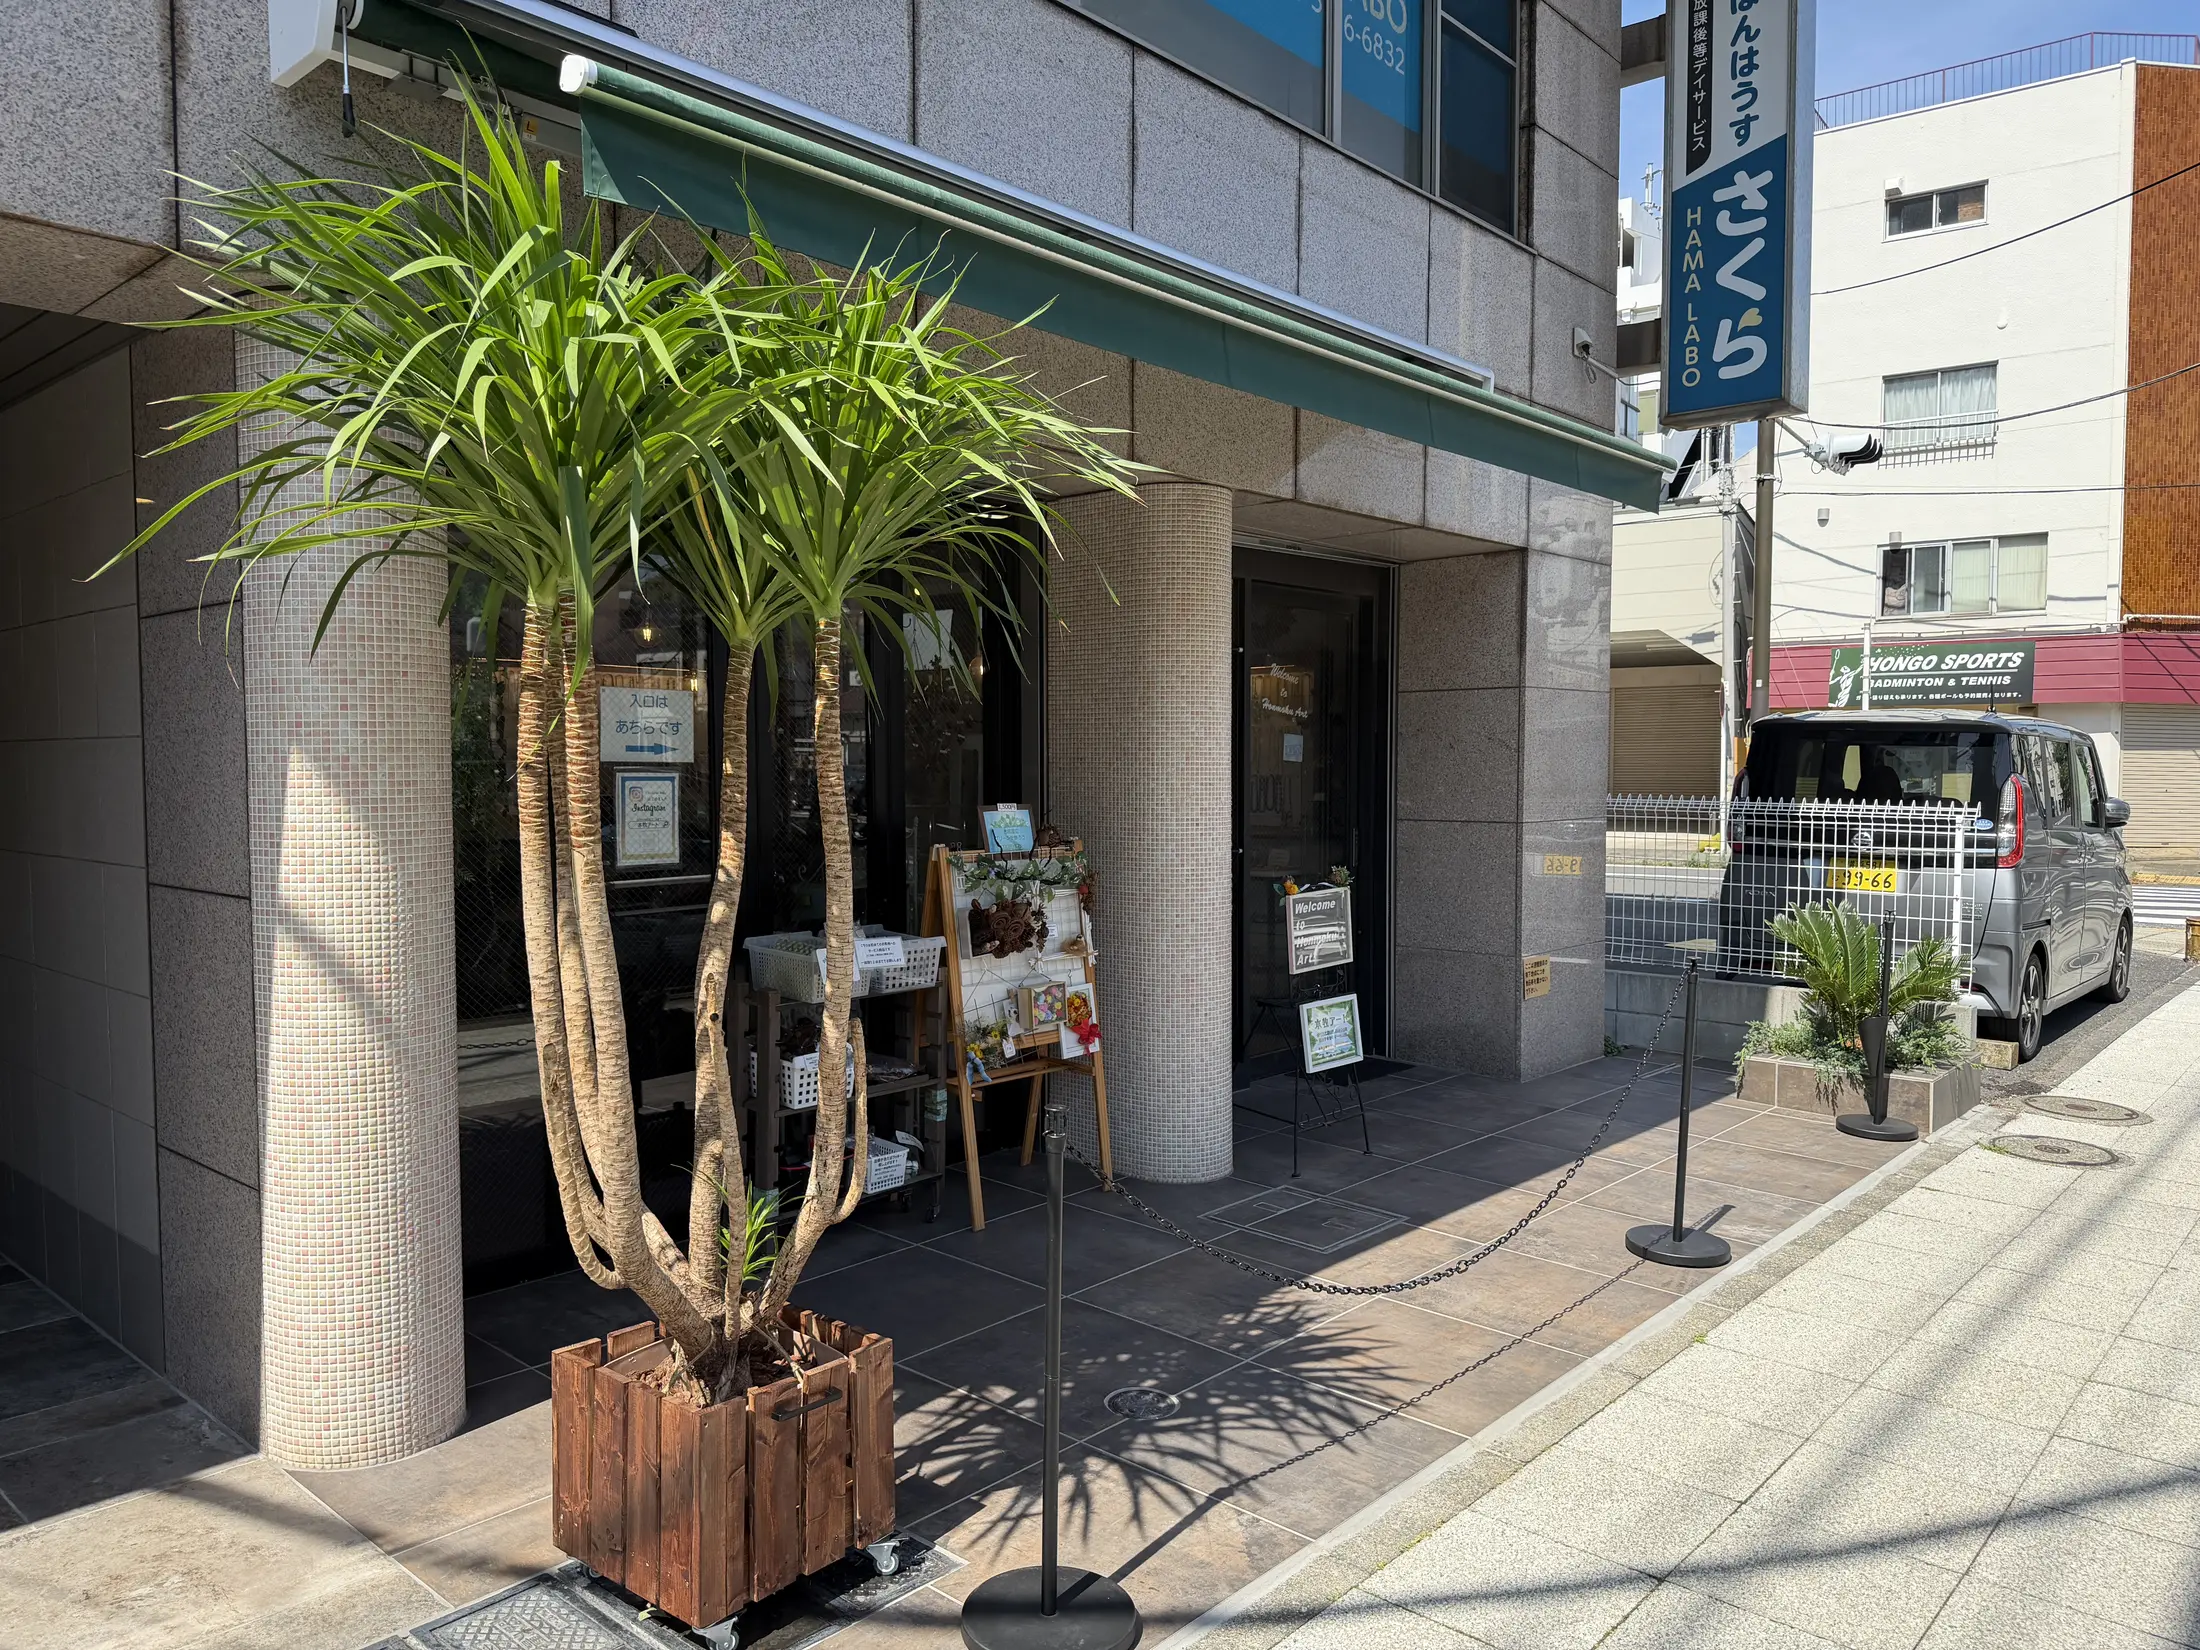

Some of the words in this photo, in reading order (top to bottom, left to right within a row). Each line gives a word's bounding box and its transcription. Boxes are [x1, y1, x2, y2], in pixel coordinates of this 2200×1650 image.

[1344, 14, 1405, 76] 6-6832
[1682, 206, 1704, 295] HAMA
[1712, 170, 1774, 380] さくら
[1681, 303, 1701, 388] LABO
[1940, 651, 2025, 670] SPORTS
[1270, 663, 1299, 684] Welcome
[1947, 678, 1956, 687] &
[1960, 675, 2012, 686] TENNIS
[629, 693, 669, 709] 入口は
[615, 719, 683, 736] あちらです
[631, 803, 666, 816] Instagram
[1841, 870, 1893, 889] 99-66
[1295, 900, 1336, 914] Welcome
[1296, 921, 1306, 931] to
